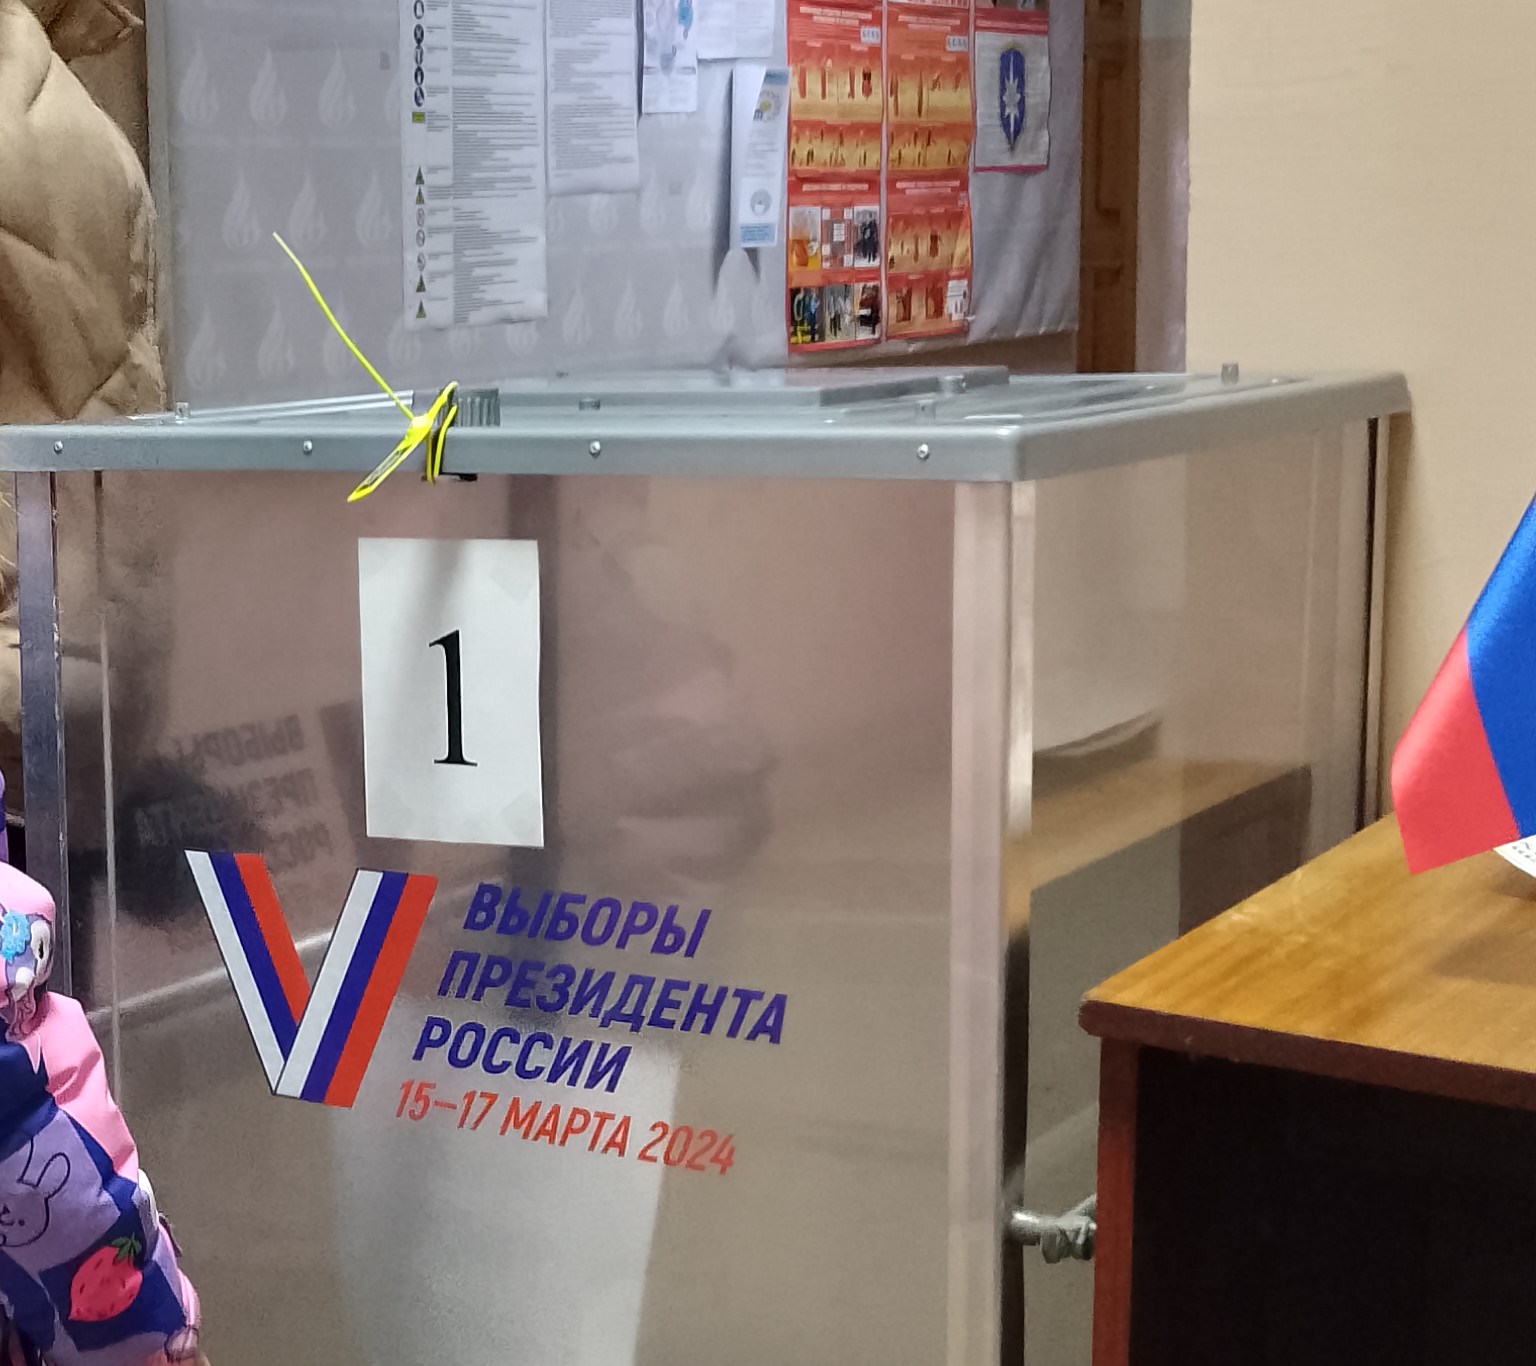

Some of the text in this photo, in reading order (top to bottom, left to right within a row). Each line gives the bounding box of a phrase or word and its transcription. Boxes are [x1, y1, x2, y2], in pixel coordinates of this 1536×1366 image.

[428, 629, 478, 767] 1
[463, 881, 712, 959] ВЫБОРЫ
[437, 950, 788, 1045] ПРЕЗИДЕНТА
[412, 1015, 632, 1093] РОССИИ
[500, 1096, 632, 1158] МАРТА
[637, 1120, 736, 1176] 2024
